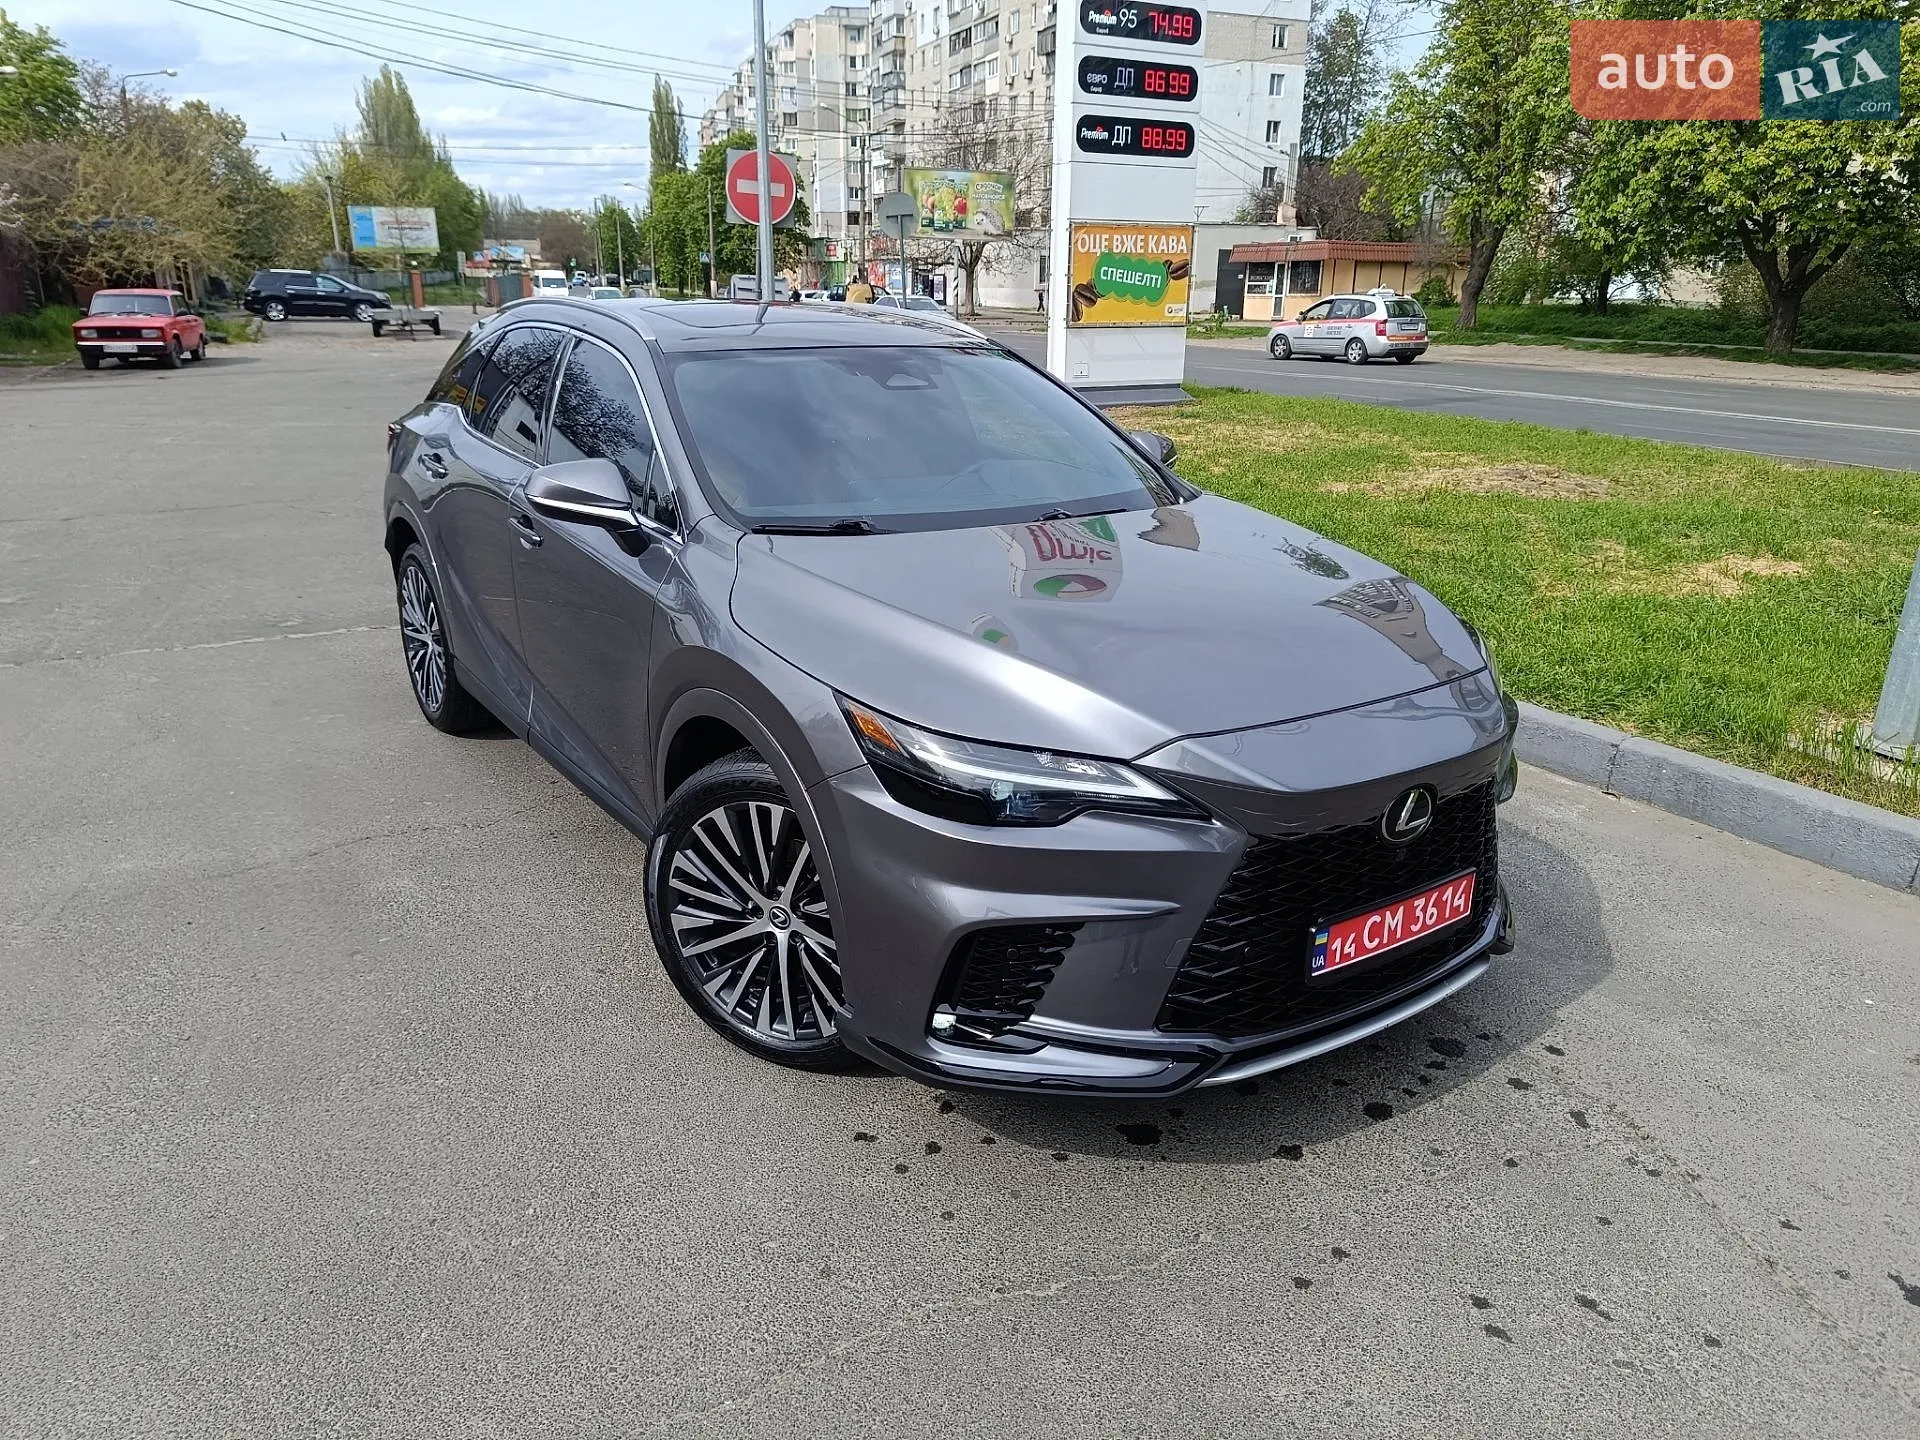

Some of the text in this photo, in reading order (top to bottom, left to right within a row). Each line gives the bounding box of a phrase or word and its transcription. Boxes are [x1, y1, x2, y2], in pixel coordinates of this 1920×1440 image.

[1088, 8, 1193, 38] Premium 95 74.99
[1114, 67, 1134, 90] ДП
[1080, 125, 1186, 151] Premium ДП 88.99
[1077, 233, 1187, 256] ОЦЕ ВЖЕ КАВА
[1100, 266, 1161, 288] СПЕШЕЛТІ
[1331, 879, 1467, 963] 14 CM 3614
[1312, 954, 1325, 968] UA
